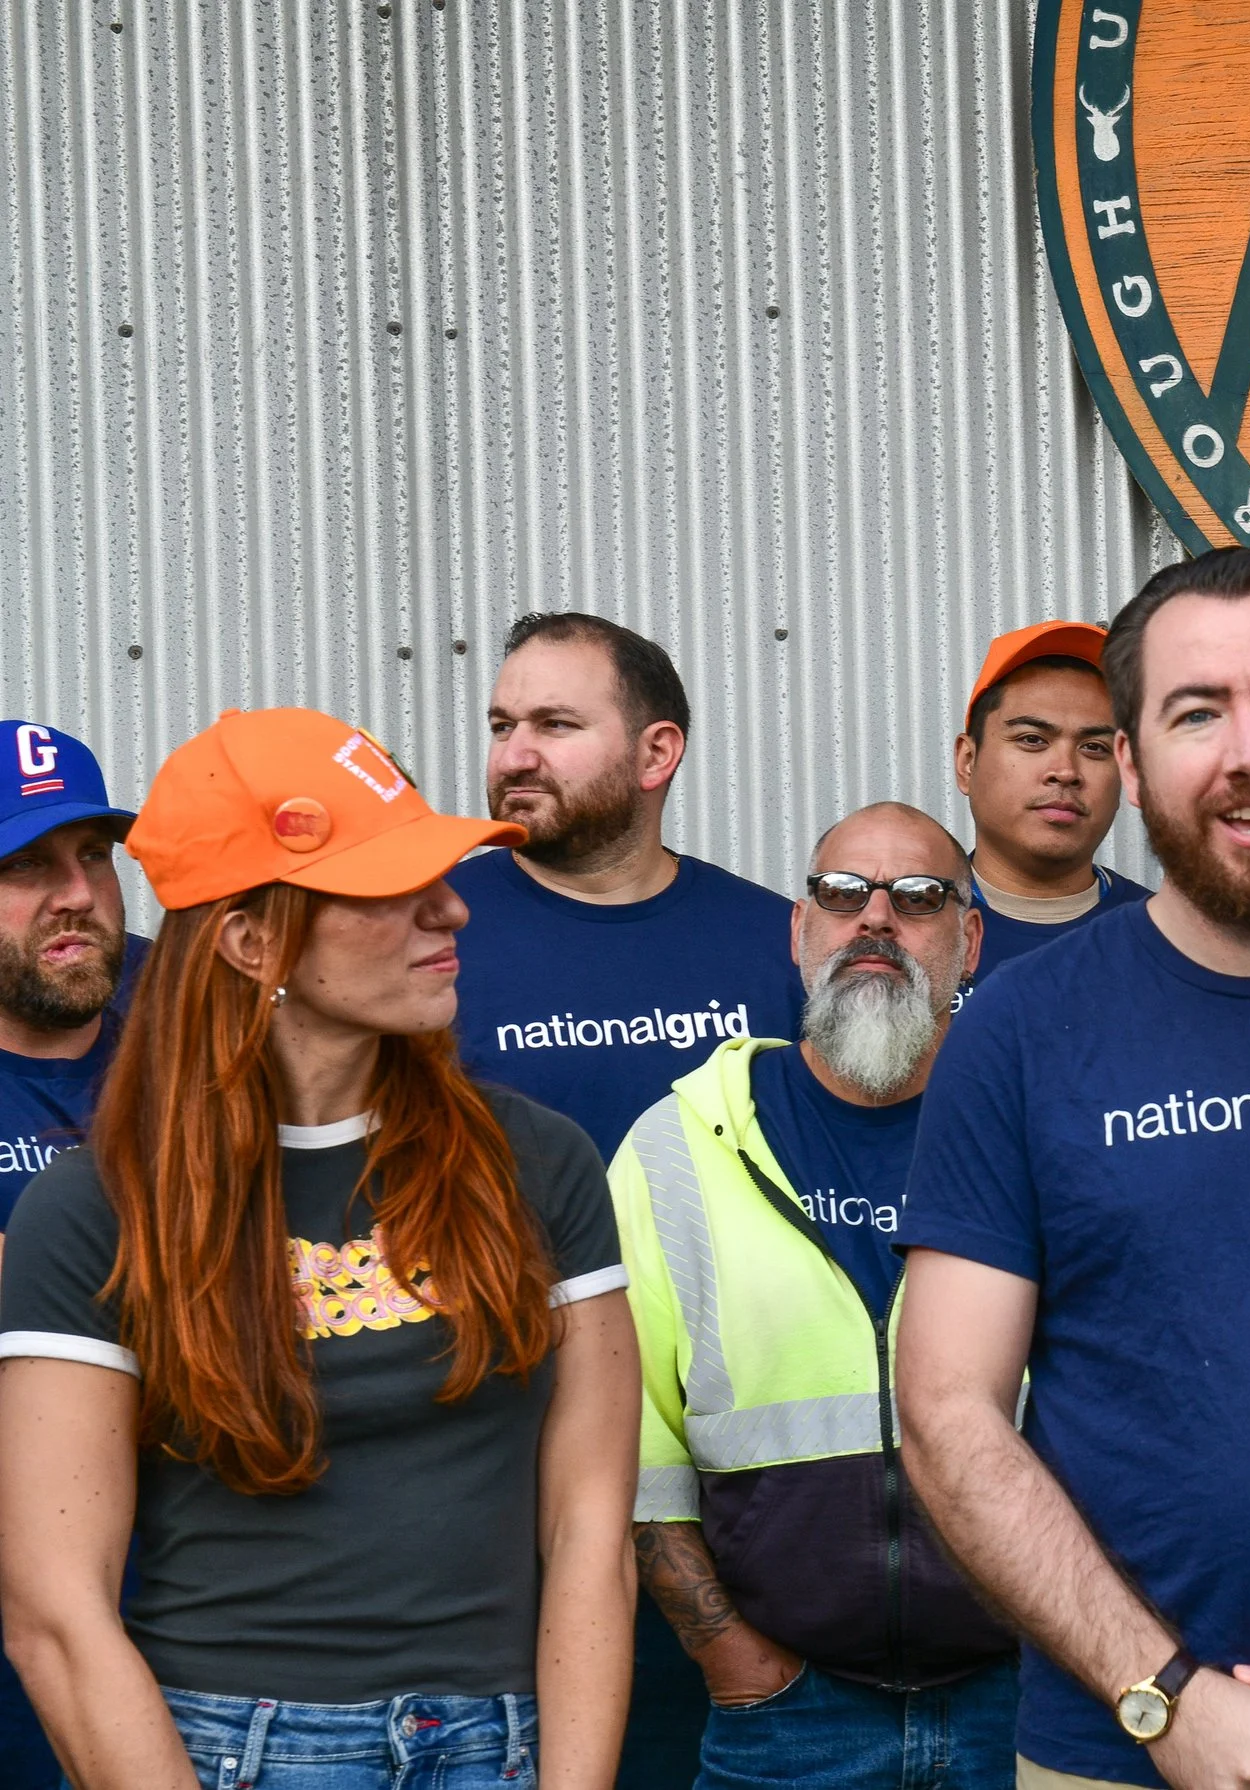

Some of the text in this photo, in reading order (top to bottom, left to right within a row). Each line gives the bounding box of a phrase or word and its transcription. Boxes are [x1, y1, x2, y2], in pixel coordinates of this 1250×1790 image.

[16, 724, 59, 778] G
[496, 999, 750, 1051] nationalgrid
[799, 1188, 908, 1233] ationa
